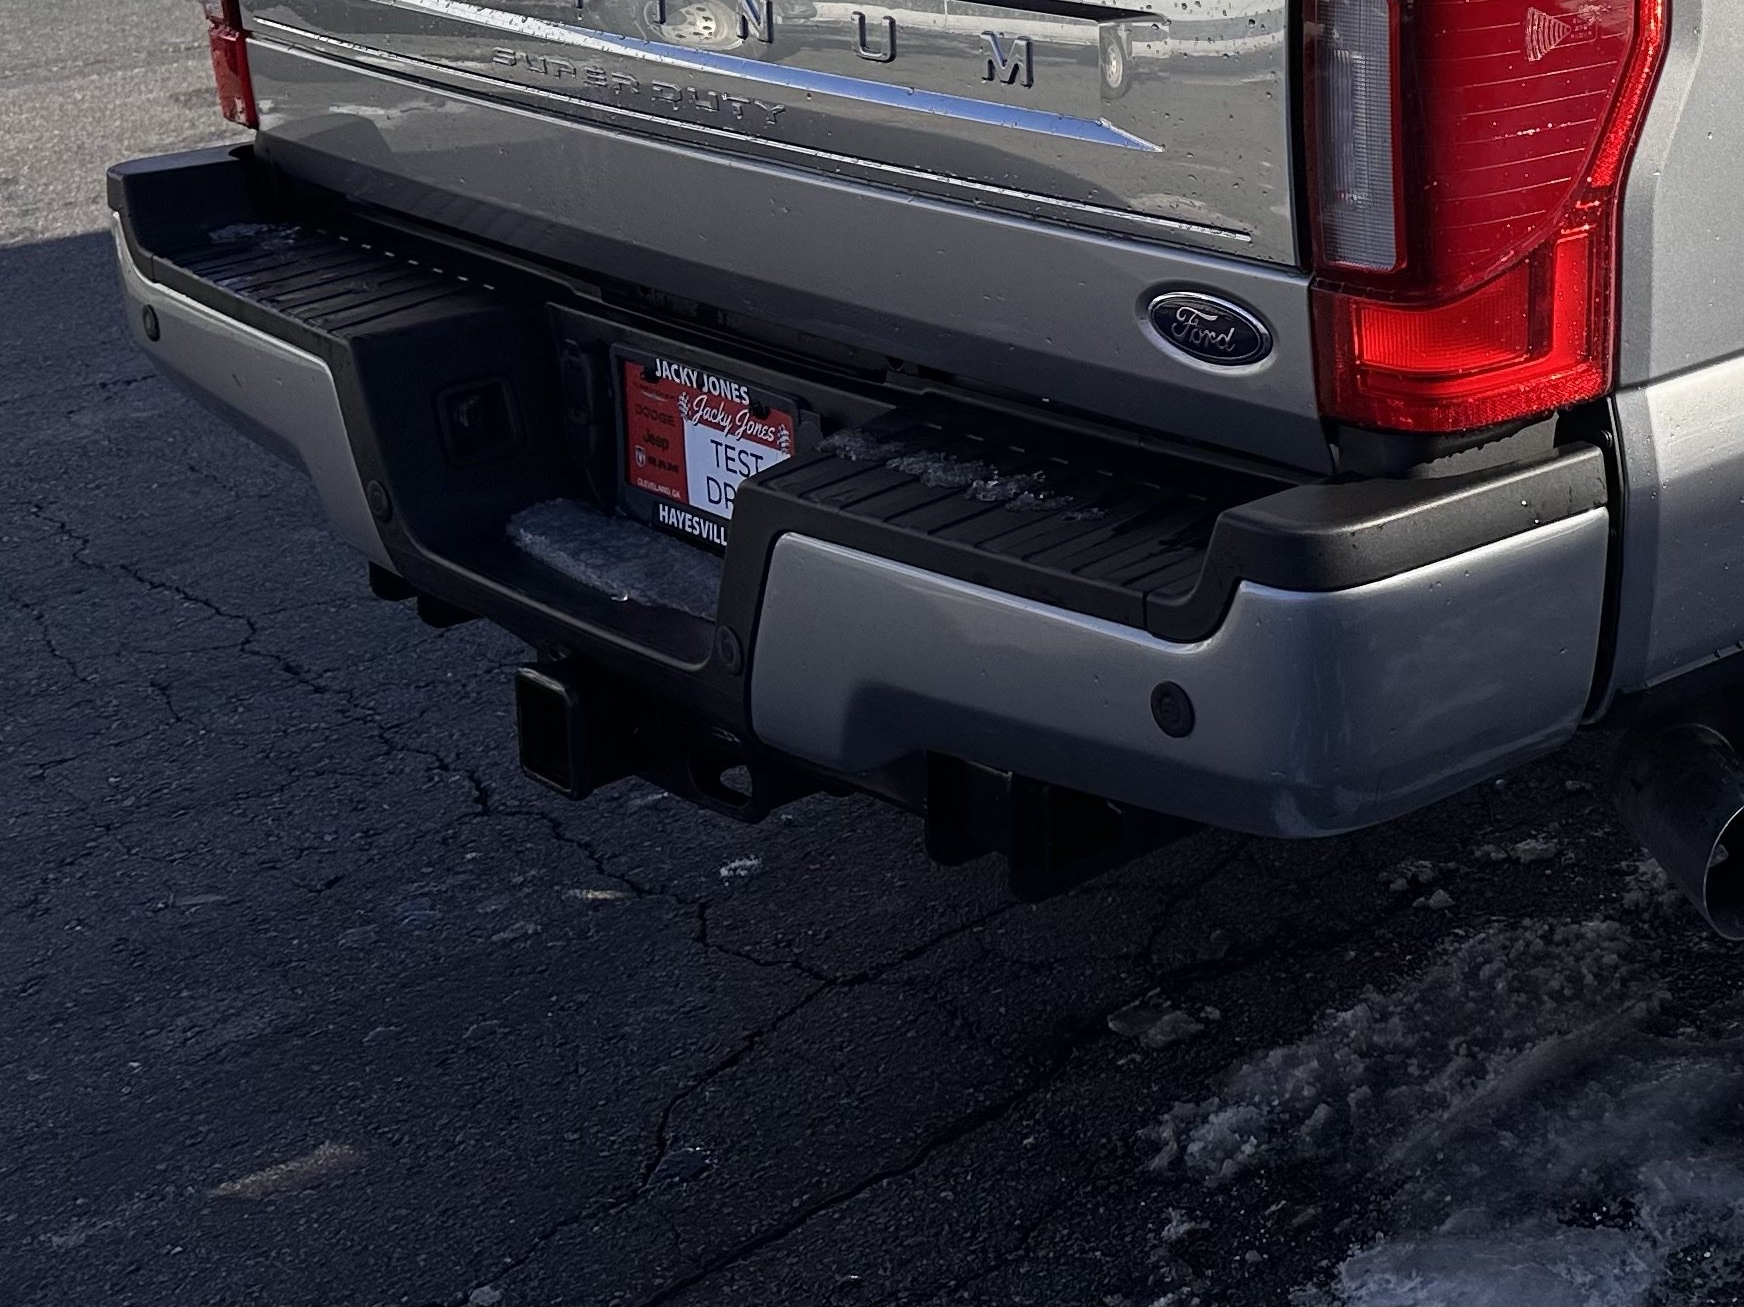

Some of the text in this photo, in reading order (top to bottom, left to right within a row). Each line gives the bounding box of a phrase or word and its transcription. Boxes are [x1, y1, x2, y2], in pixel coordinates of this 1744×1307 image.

[492, 46, 786, 125] SUPER DUTY
[1171, 306, 1235, 352] Ford
[655, 357, 698, 389] JACKY
[702, 373, 750, 405] JONES
[634, 403, 675, 427] DODGE
[692, 394, 775, 441] Jacky Jones
[642, 428, 670, 452] Jeep
[710, 439, 764, 478] TEST
[659, 503, 728, 547] HAYESVILL
